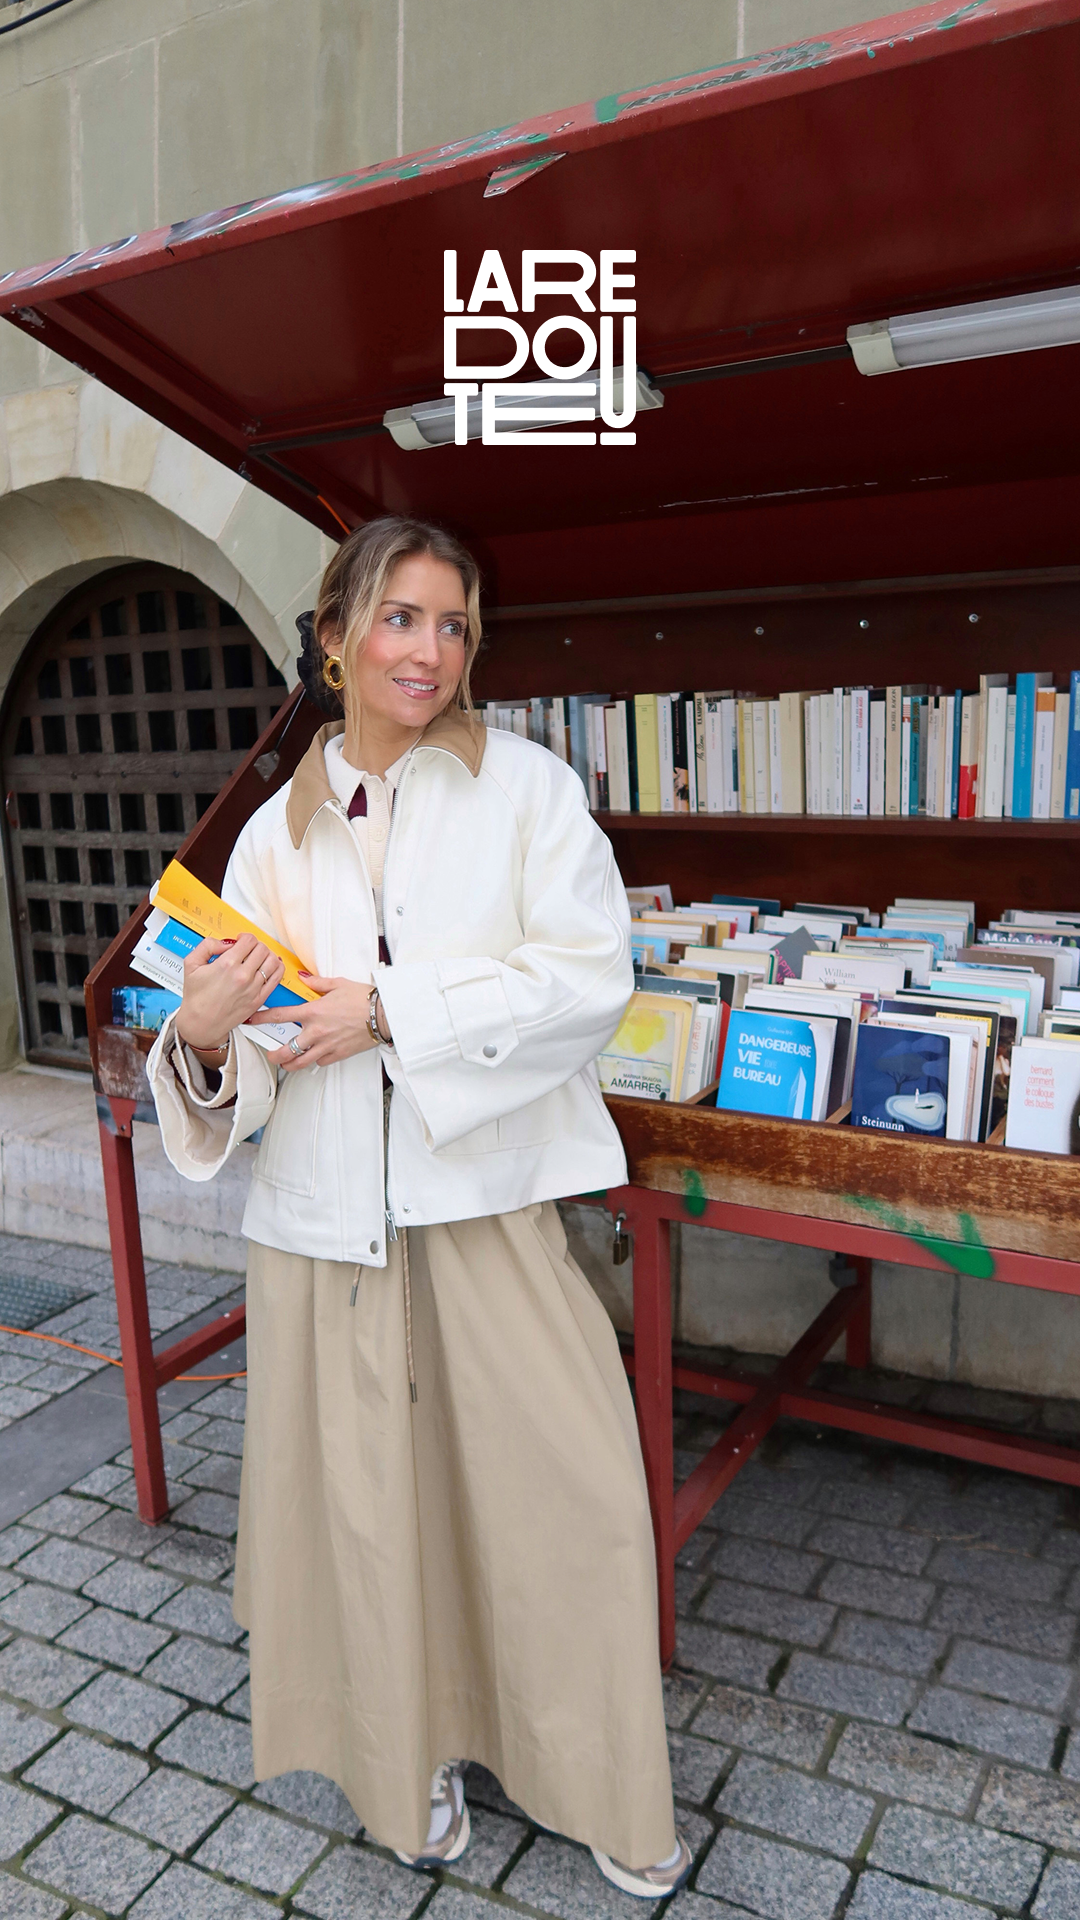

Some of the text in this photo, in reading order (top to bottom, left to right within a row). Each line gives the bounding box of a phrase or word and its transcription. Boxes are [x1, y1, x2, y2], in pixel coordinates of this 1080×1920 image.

[824, 967, 856, 979] William
[738, 1032, 812, 1058] DANGEREUSE
[737, 1048, 763, 1066] VIE
[732, 1066, 782, 1086] BUREAU
[1030, 1064, 1053, 1076] bernard
[610, 1078, 662, 1094] AMARRES
[1027, 1076, 1055, 1088] comment
[1023, 1097, 1055, 1110] des bustes
[861, 1115, 905, 1132] Steinunn
